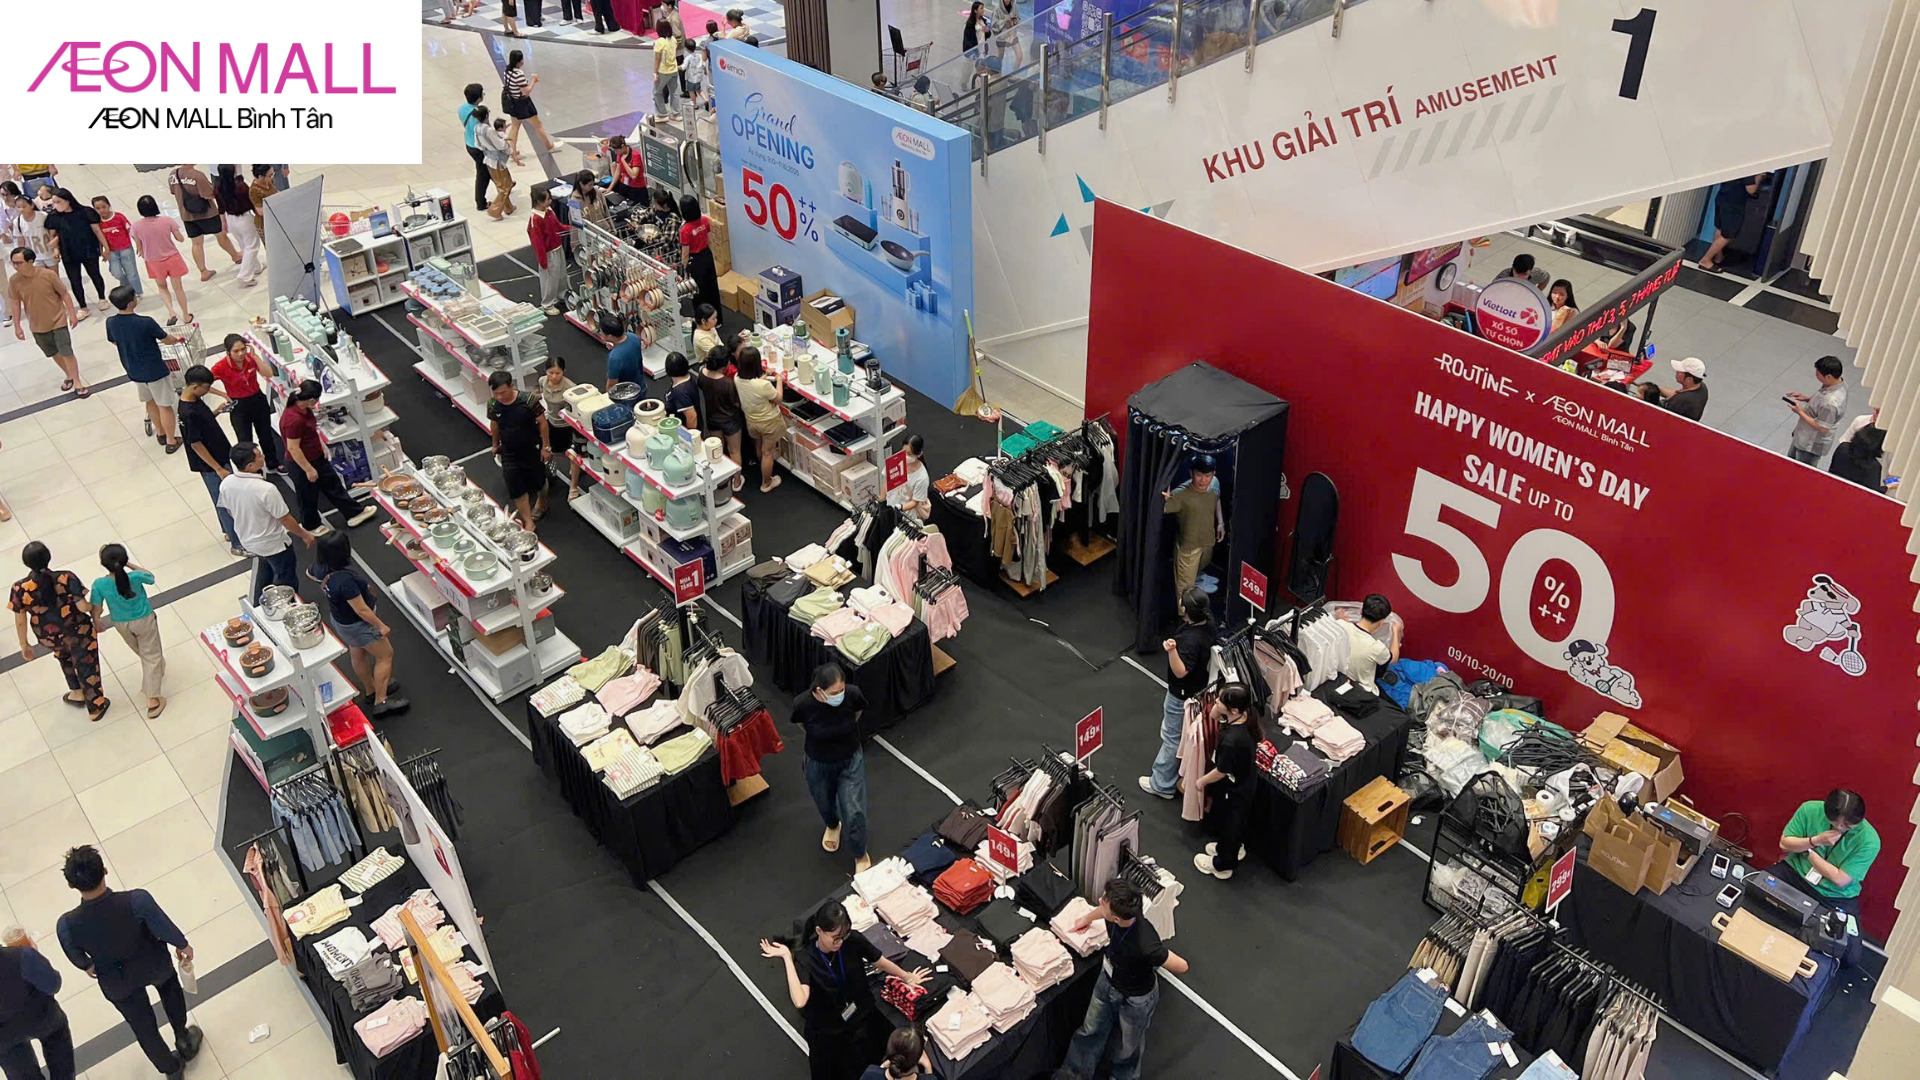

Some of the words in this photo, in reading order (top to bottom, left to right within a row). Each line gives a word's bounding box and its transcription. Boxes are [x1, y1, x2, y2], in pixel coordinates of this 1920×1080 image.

[1611, 7, 1657, 100] 1
[744, 92, 798, 136] Grand
[1203, 140, 1265, 183] KHU
[1272, 110, 1338, 161] GIẢI
[1341, 85, 1402, 138] TRÍ
[1415, 54, 1558, 119] AMUSEMENT
[731, 113, 815, 170] OPENING
[742, 166, 798, 241] 50
[1483, 297, 1518, 319] Vietlott
[1414, 390, 1486, 440] HAPPY
[1488, 420, 1596, 489] WOMEN'S
[1598, 469, 1651, 511] DAY
[1575, 423, 1599, 439] MALL
[1600, 433, 1619, 447] Bình
[1619, 440, 1635, 453] Tân
[1597, 413, 1651, 448] MALL
[1462, 453, 1527, 505] SALE
[1528, 487, 1551, 507] UP
[1554, 498, 1574, 522] TO
[692, 569, 700, 588] 1
[1391, 466, 1616, 672] 50
[1543, 575, 1571, 610] %
[1447, 645, 1514, 690] 09/10-20/10
